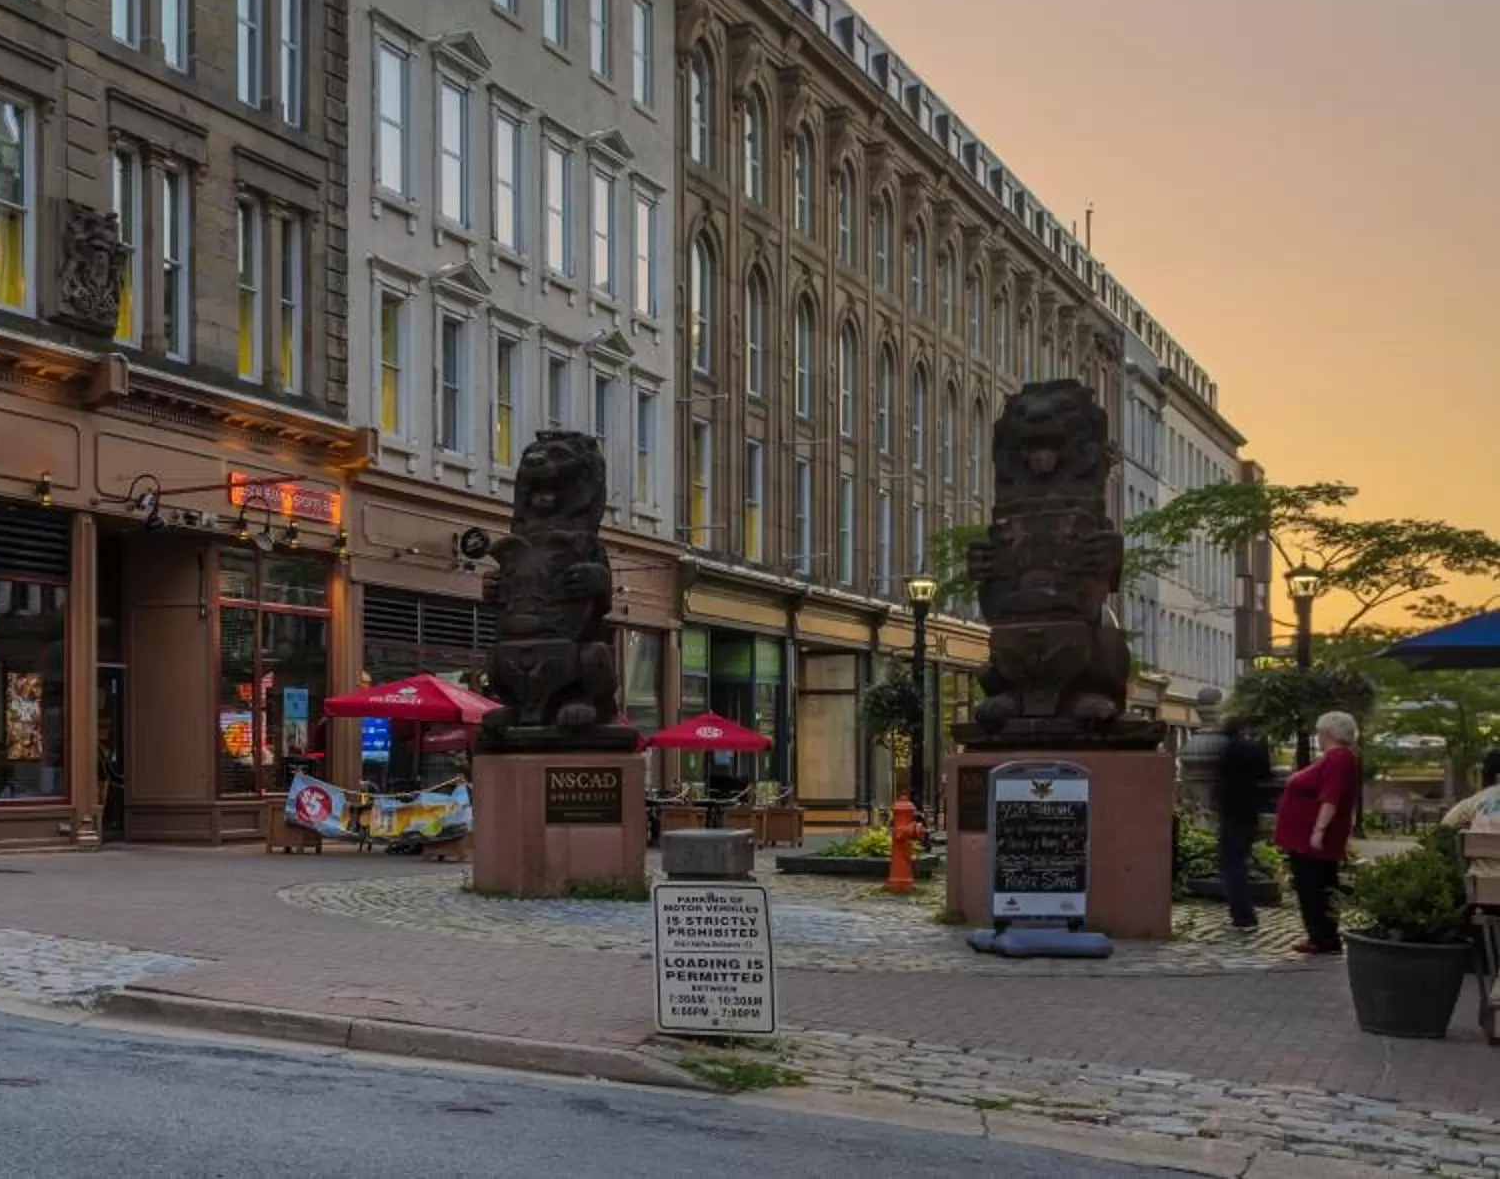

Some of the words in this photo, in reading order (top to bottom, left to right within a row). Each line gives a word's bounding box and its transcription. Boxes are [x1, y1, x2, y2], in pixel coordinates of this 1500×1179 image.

[549, 772, 618, 789] NSCAD
[663, 904, 703, 912] MOTOR
[705, 904, 759, 914] VEHICLES
[666, 916, 681, 926] IS
[685, 916, 757, 926] STRICTLY
[667, 927, 759, 938] PROHIBITED
[664, 957, 741, 969] LOADING
[747, 958, 764, 970] IS
[665, 971, 764, 983] PERMITTED
